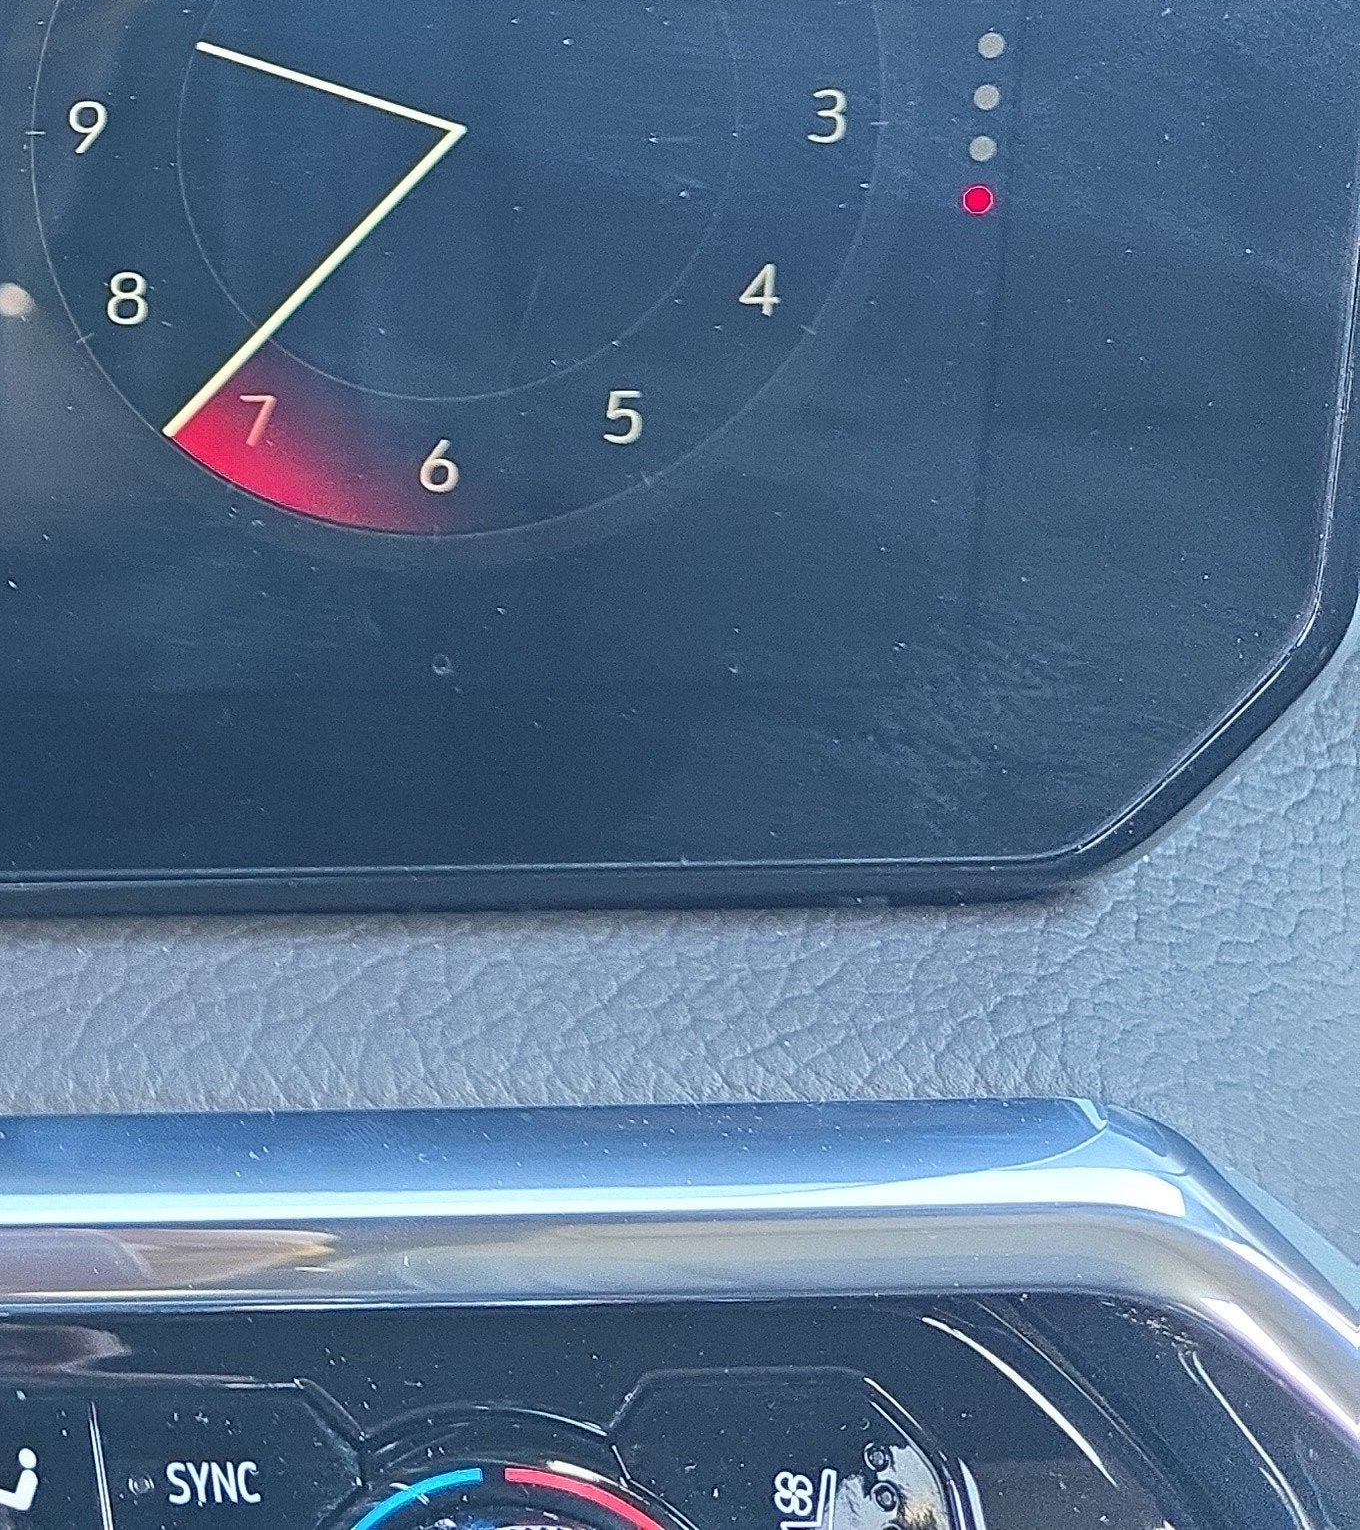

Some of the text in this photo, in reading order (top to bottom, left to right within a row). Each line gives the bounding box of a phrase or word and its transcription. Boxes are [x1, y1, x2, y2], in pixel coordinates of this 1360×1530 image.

[67, 99, 109, 155] 9
[807, 87, 850, 145] 3
[106, 271, 151, 327] 8
[738, 263, 783, 318] 4
[238, 394, 278, 448] 7
[604, 389, 644, 446] 5
[418, 437, 461, 494] 6
[166, 1460, 262, 1506] SYNC
